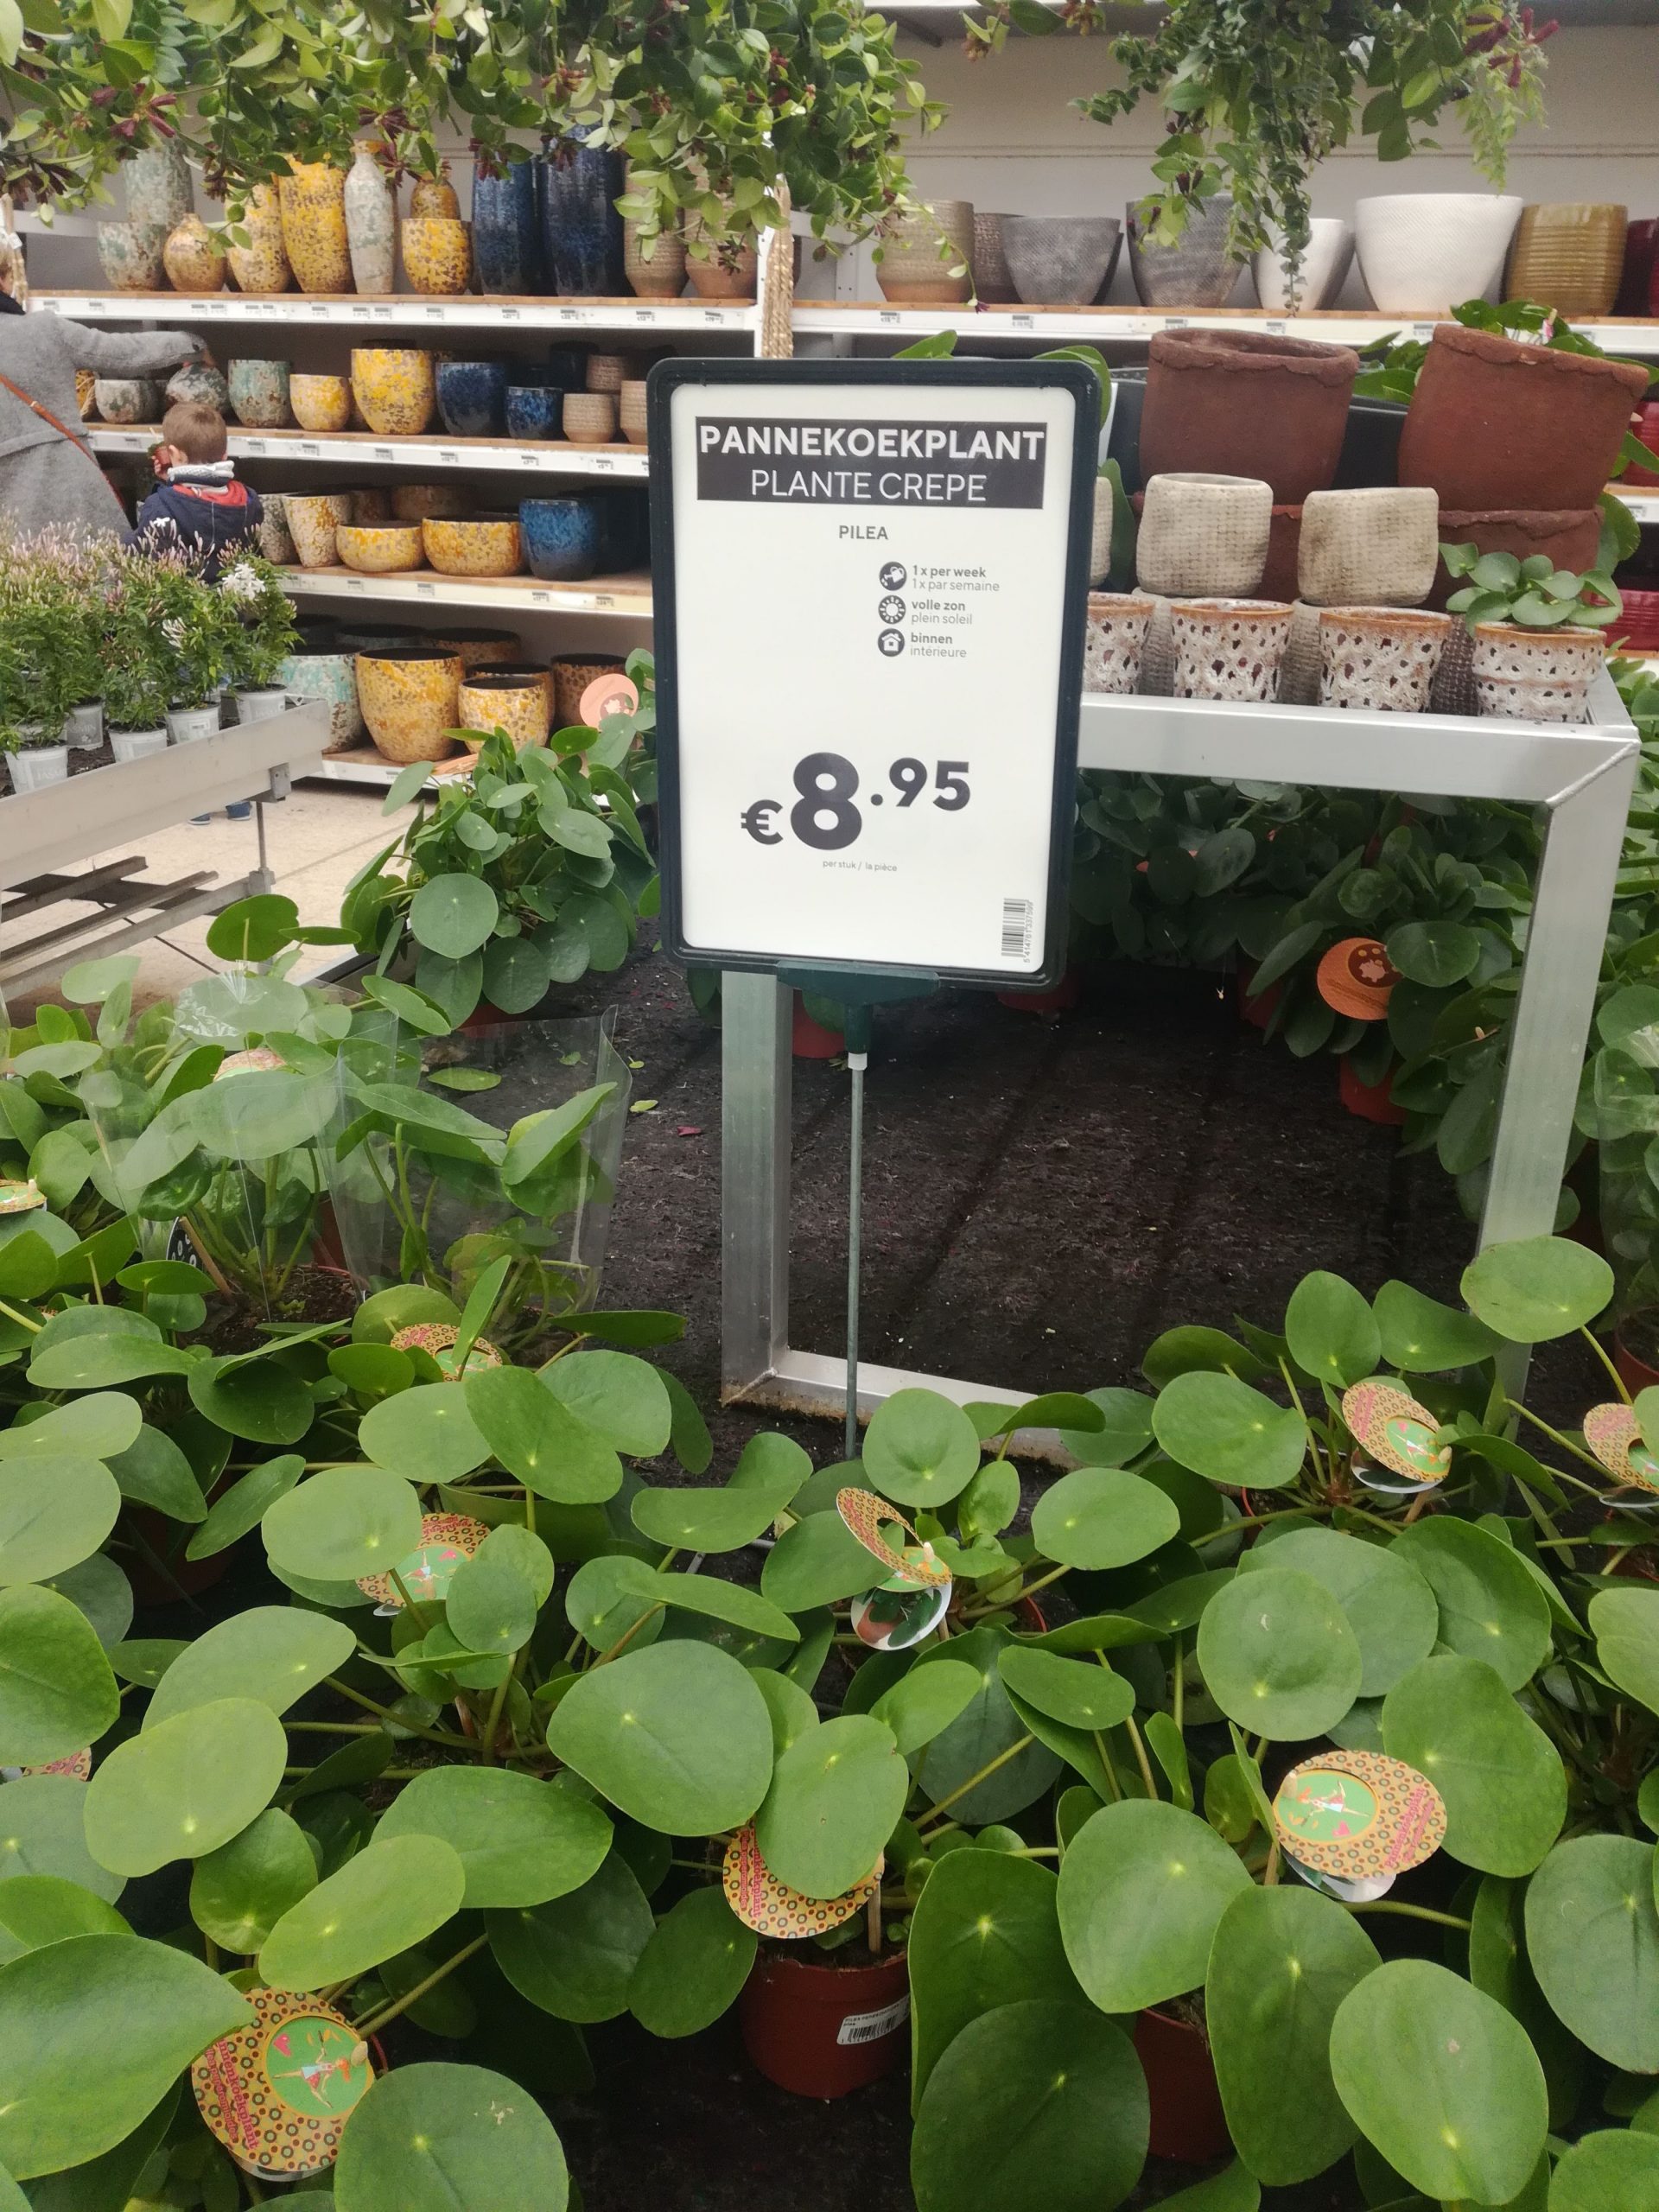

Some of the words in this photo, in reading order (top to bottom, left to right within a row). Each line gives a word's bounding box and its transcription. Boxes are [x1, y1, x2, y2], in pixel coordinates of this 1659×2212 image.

[700, 424, 1045, 461] PANNEKOEKPLANT
[751, 469, 872, 499] PLANTE
[879, 472, 987, 502] CREPE
[838, 524, 889, 541] PILEA
[930, 567, 951, 579] per
[953, 566, 987, 578] week
[928, 581, 948, 593] par
[950, 581, 1001, 592] semaine
[911, 599, 941, 610] volle
[943, 602, 966, 612] zon
[911, 612, 940, 626] plein
[942, 613, 973, 625] soleil
[910, 632, 953, 645] binnen
[823, 861, 837, 869] per
[838, 861, 856, 870] stuk
[865, 861, 873, 870] la
